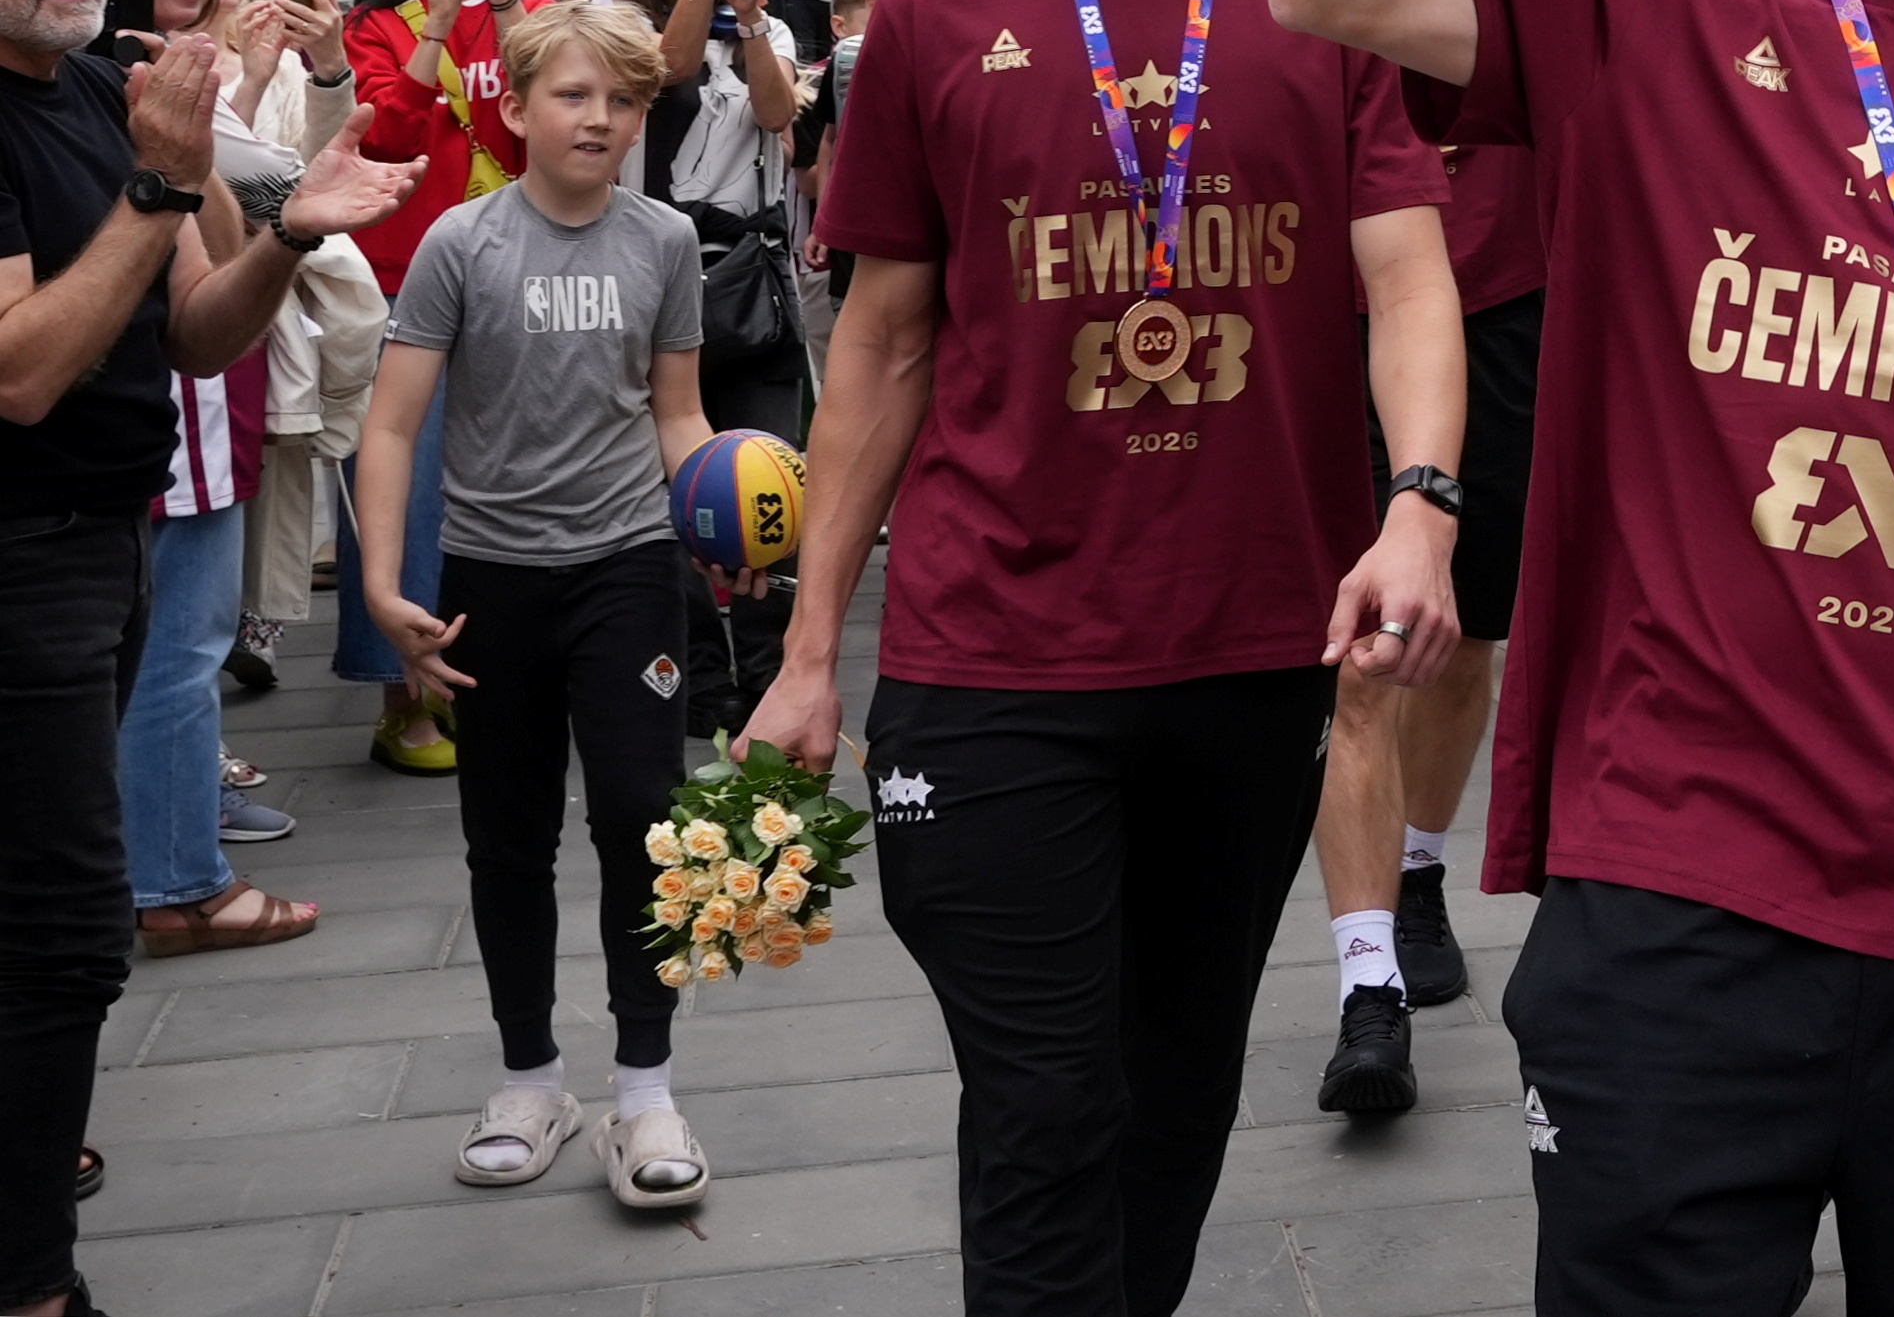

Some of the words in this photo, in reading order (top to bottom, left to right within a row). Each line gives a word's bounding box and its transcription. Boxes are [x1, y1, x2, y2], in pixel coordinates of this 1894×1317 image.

[981, 48, 1033, 74] PEAK
[1733, 55, 1792, 93] PEAK
[1092, 117, 1212, 136] LTVIA
[551, 274, 623, 331] NBA
[1126, 431, 1200, 454] 2026
[877, 809, 936, 823] LATVIJA
[1344, 944, 1384, 961] PEAK
